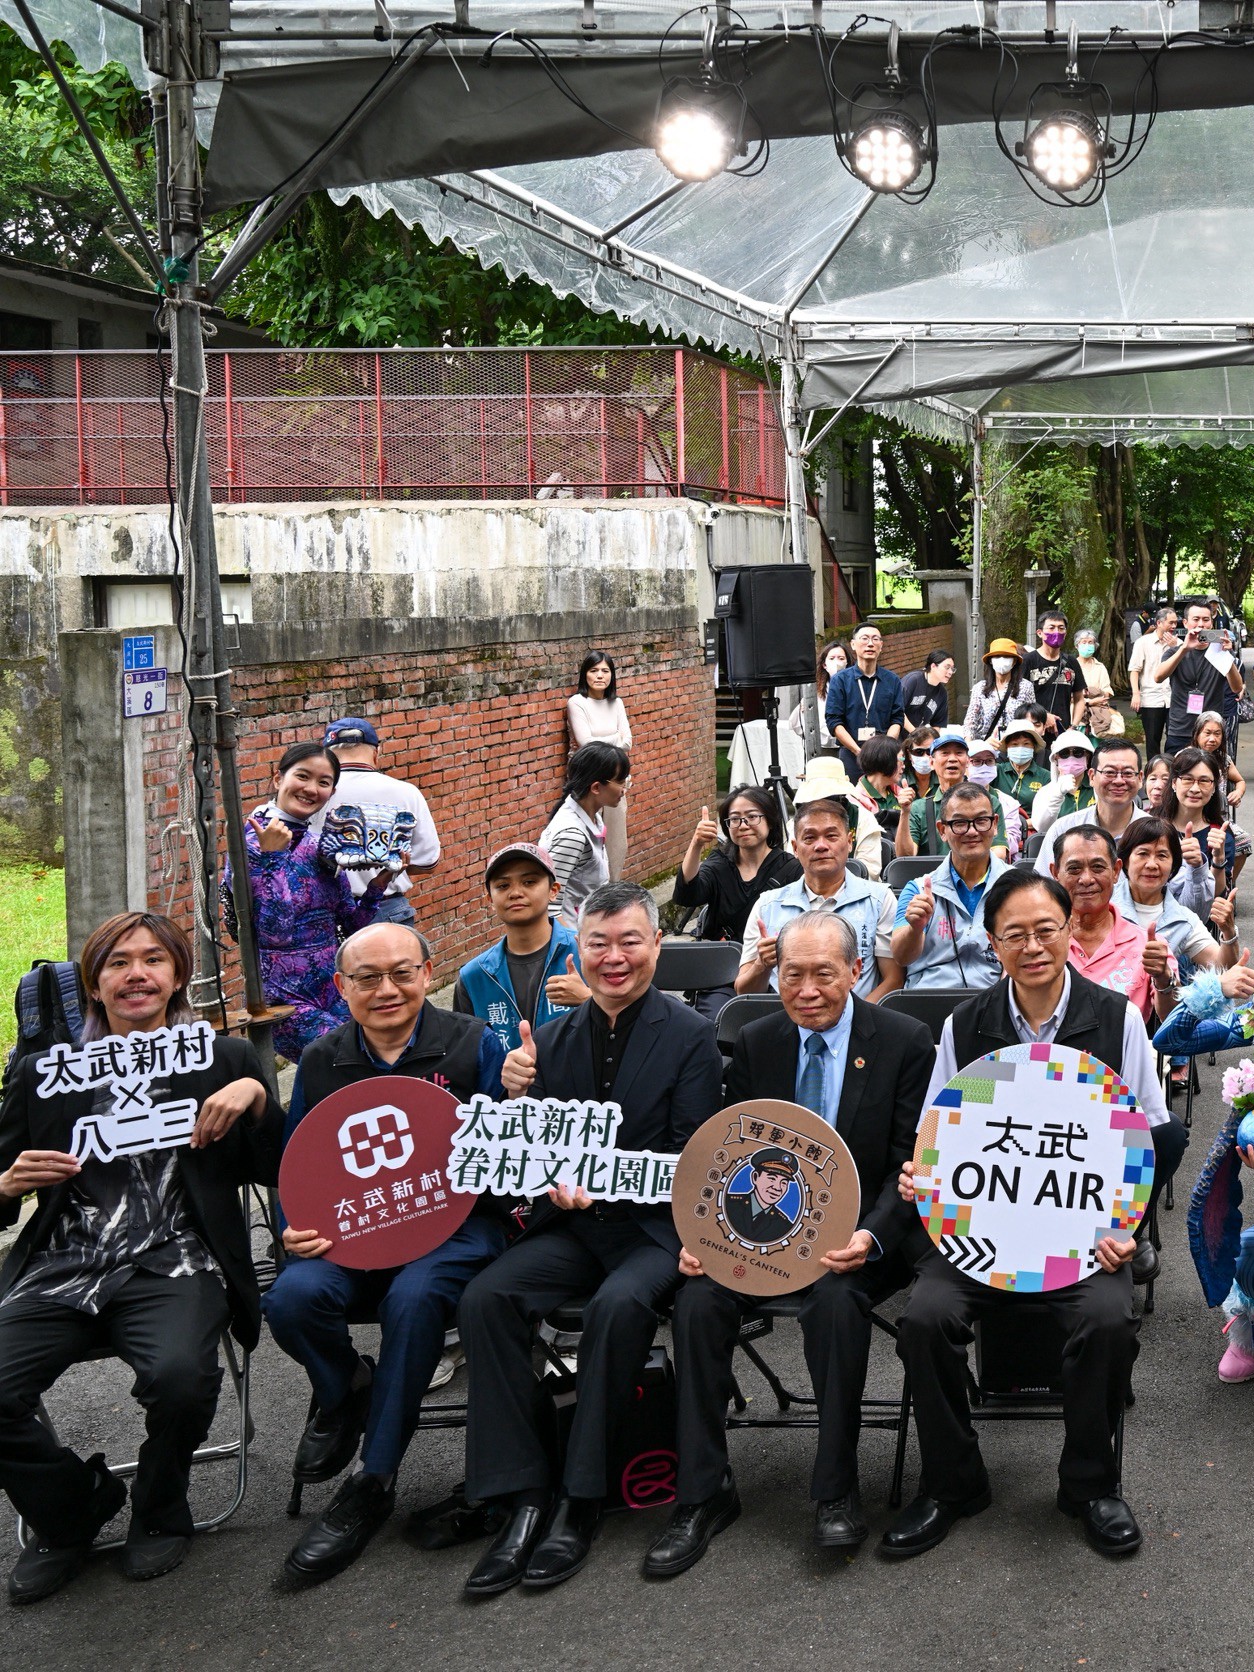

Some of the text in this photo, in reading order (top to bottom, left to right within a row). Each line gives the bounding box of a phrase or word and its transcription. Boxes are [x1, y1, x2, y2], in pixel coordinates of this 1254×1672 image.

[140, 654, 148, 664] 25
[144, 691, 153, 711] 8
[44, 1026, 209, 1092] 太武新村
[76, 1104, 194, 1158] 八二三
[457, 1100, 617, 1148] 太武新村
[982, 1116, 1088, 1162] 太武
[334, 1169, 442, 1219] 太武新村
[452, 1146, 680, 1198] 眷村文化園區
[951, 1161, 1105, 1212] ON AIR
[338, 1189, 447, 1233] 眷村文化園區
[341, 1202, 449, 1241] TAIWU NEW VILLAGE CULTURAL PARK
[700, 1237, 747, 1262] GENERAL'S
[749, 1258, 790, 1279] CANTEEN
